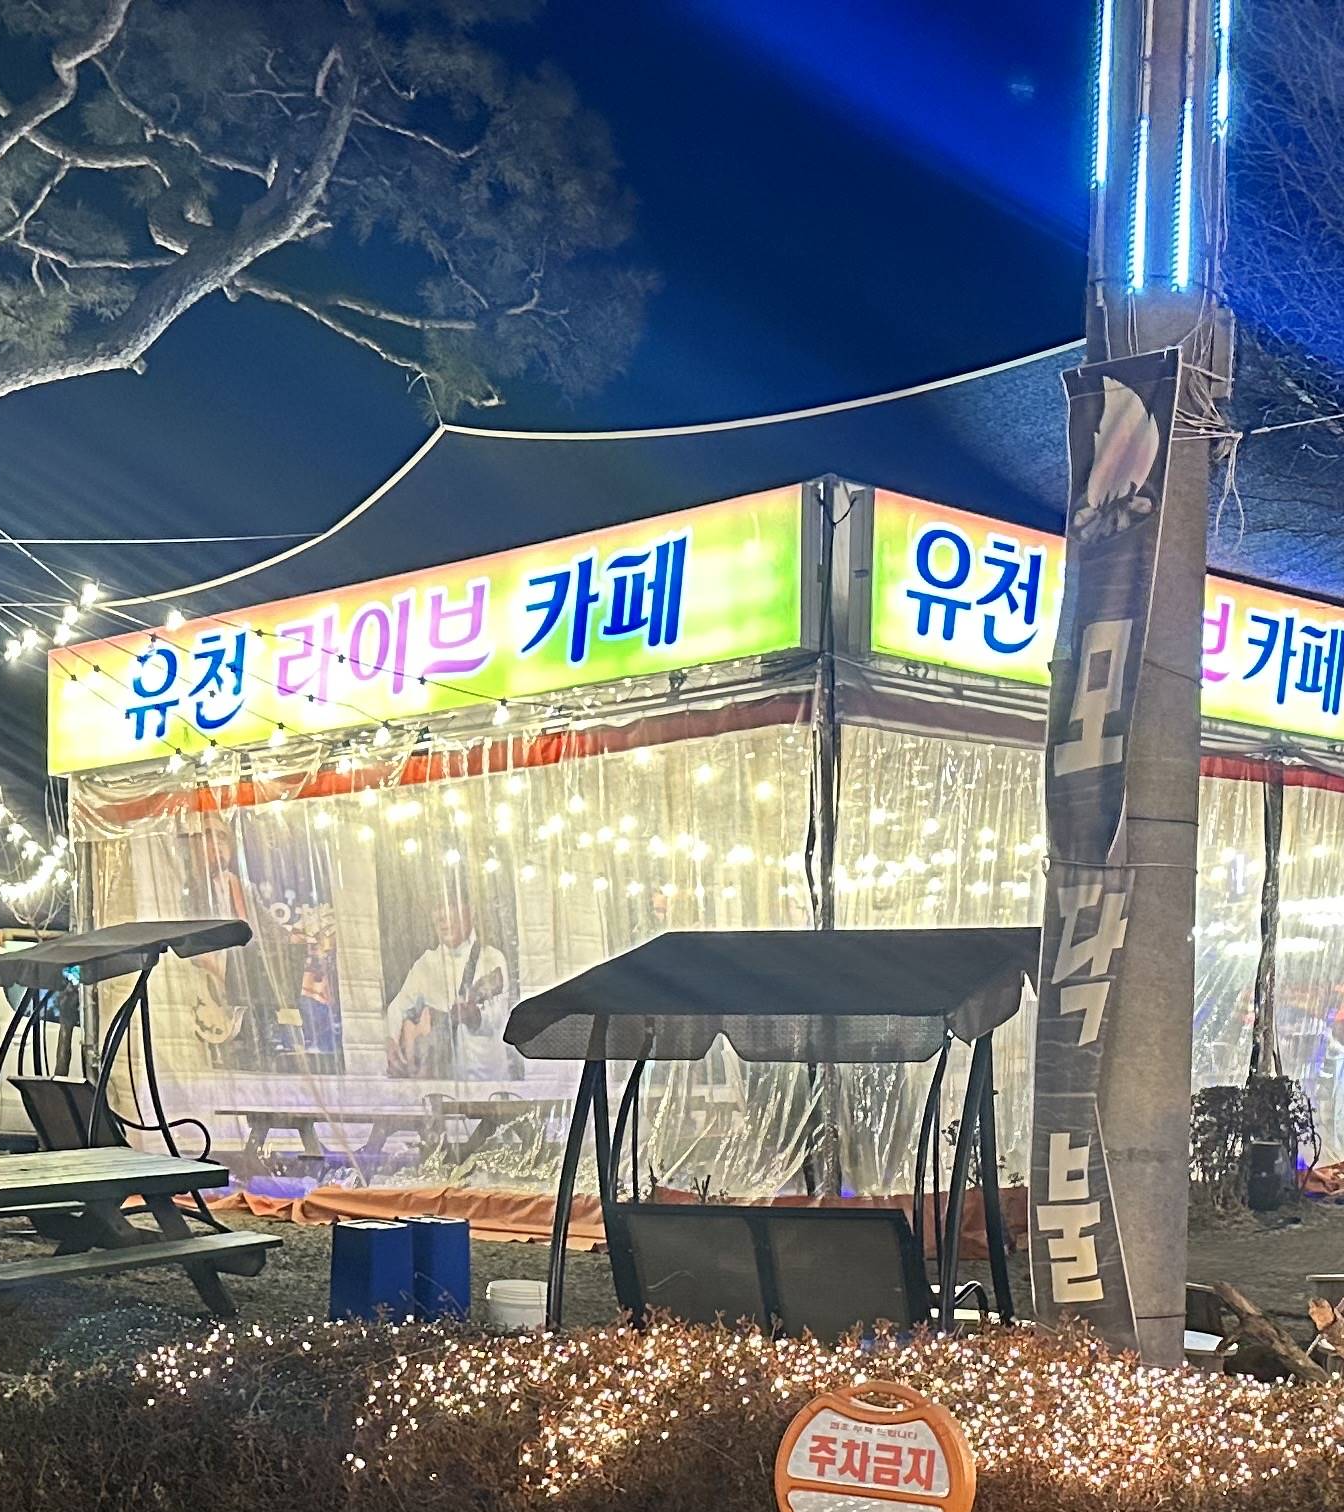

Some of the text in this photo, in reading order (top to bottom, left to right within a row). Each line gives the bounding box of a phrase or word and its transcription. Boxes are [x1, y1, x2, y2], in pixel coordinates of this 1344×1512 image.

[124, 536, 690, 742] 유천 라이브 카페
[905, 529, 1042, 654] 유천
[1036, 619, 1133, 1303] 모닥불
[809, 1435, 936, 1491] 주차금지
